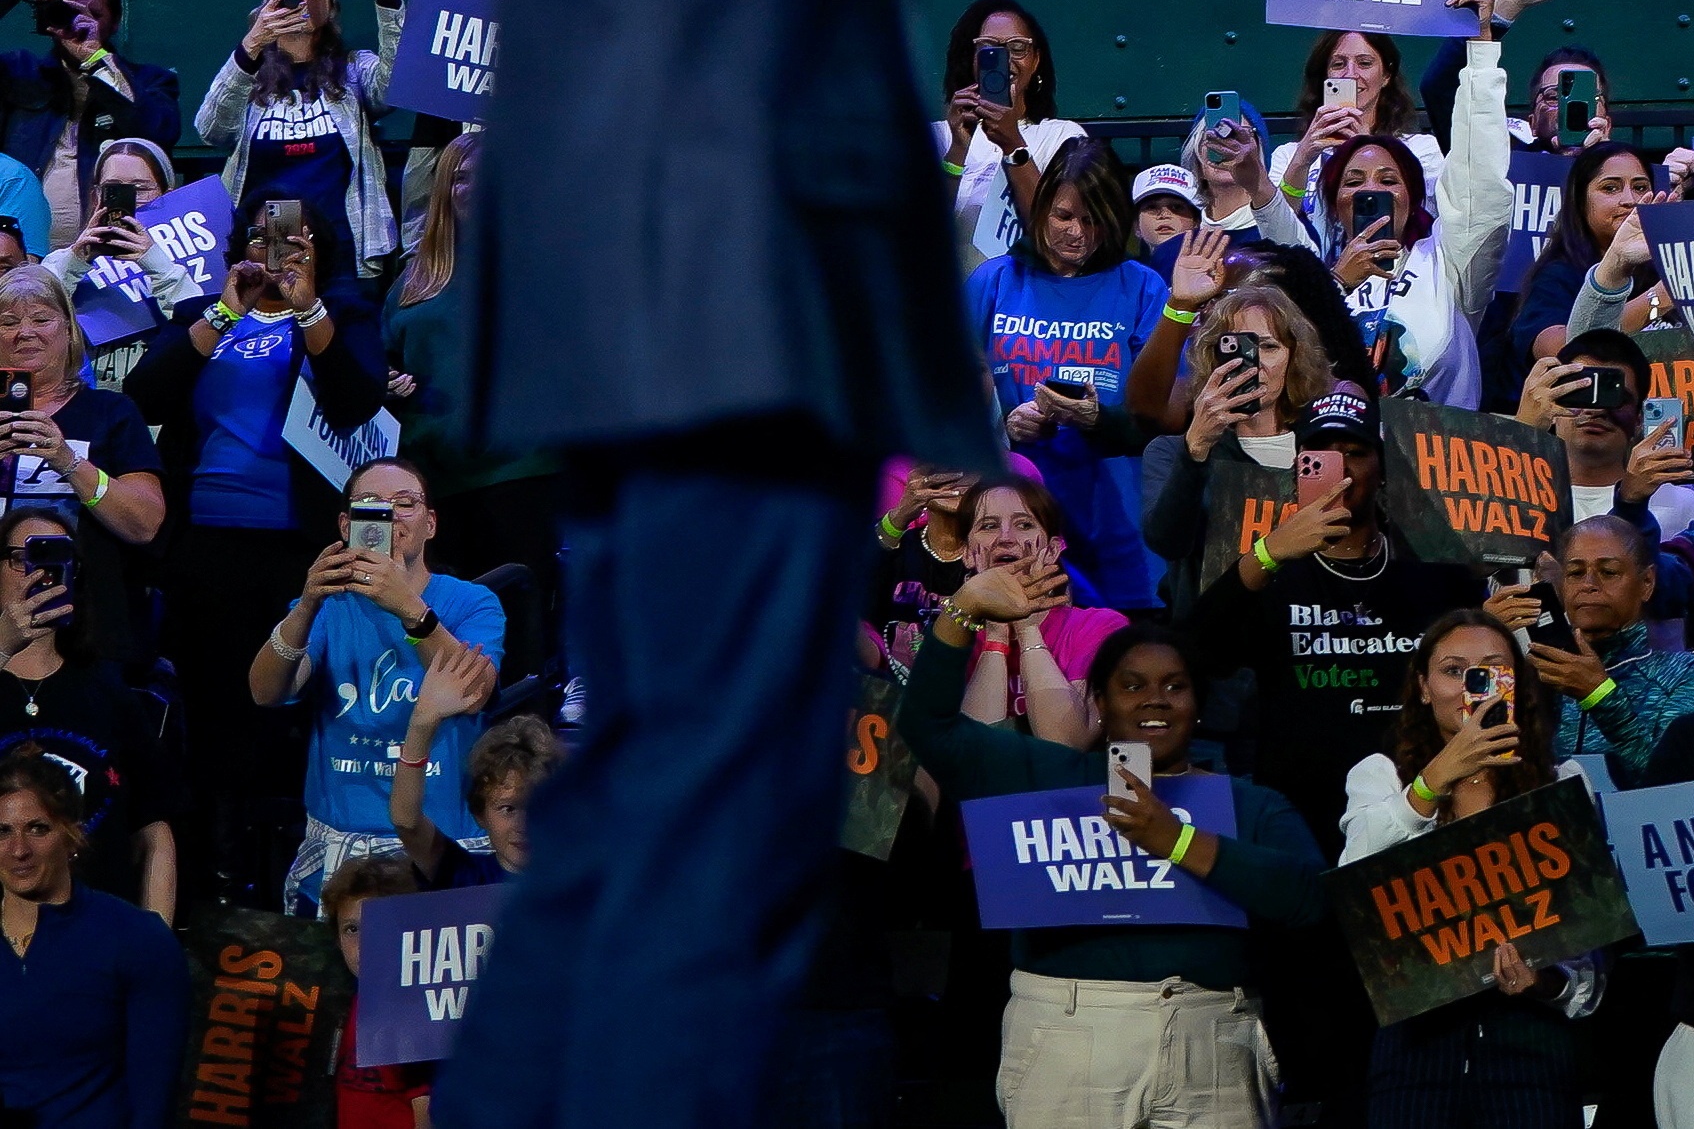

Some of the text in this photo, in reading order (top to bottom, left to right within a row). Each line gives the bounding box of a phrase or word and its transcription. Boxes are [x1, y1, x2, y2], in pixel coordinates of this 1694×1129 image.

[447, 63, 495, 97] WA
[257, 119, 338, 141] PRESID
[149, 210, 217, 262] RIS
[993, 313, 1114, 340] EDUCATORS
[993, 335, 1122, 370] KAMALA
[1010, 362, 1053, 386] TIM
[1312, 395, 1366, 411] HARRIS
[1317, 404, 1356, 416] WALZ
[1416, 432, 1558, 514] HARRIS
[1444, 496, 1551, 543] WALZ
[1289, 602, 1383, 627] Black.
[1295, 663, 1379, 689] Voter.
[373, 760, 398, 777] Wal
[1642, 823, 1670, 870] A
[1046, 859, 1176, 893] WALZ
[1370, 821, 1572, 941] HARRIS
[1420, 887, 1561, 967] WALZ
[191, 944, 283, 1128] HARRIS
